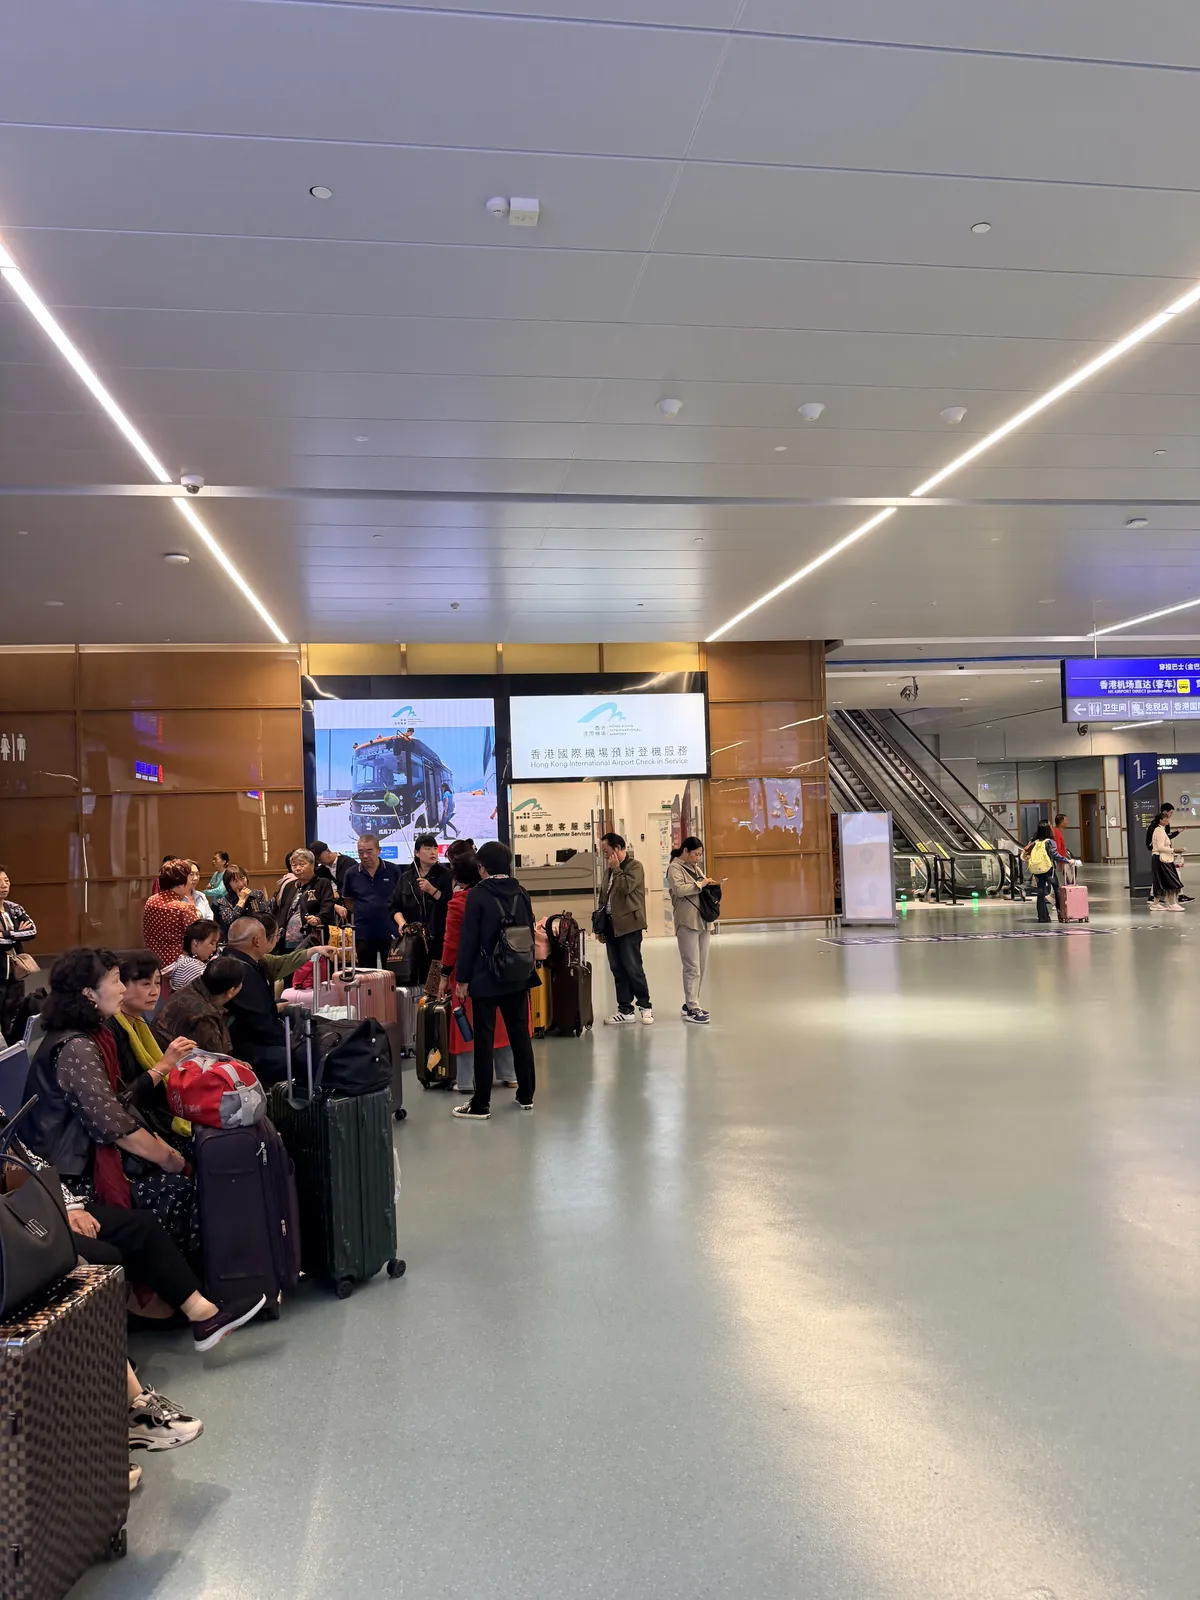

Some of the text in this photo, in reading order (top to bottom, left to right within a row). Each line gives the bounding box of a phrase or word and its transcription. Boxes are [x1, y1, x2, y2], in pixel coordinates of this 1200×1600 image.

[1100, 679, 1176, 690] 香港机场直达(客车)
[1103, 704, 1126, 712] 卫生间
[1146, 703, 1168, 711] 免税店
[530, 746, 688, 760] 香港國際機場預辦登機服務
[550, 760, 568, 768] Kong
